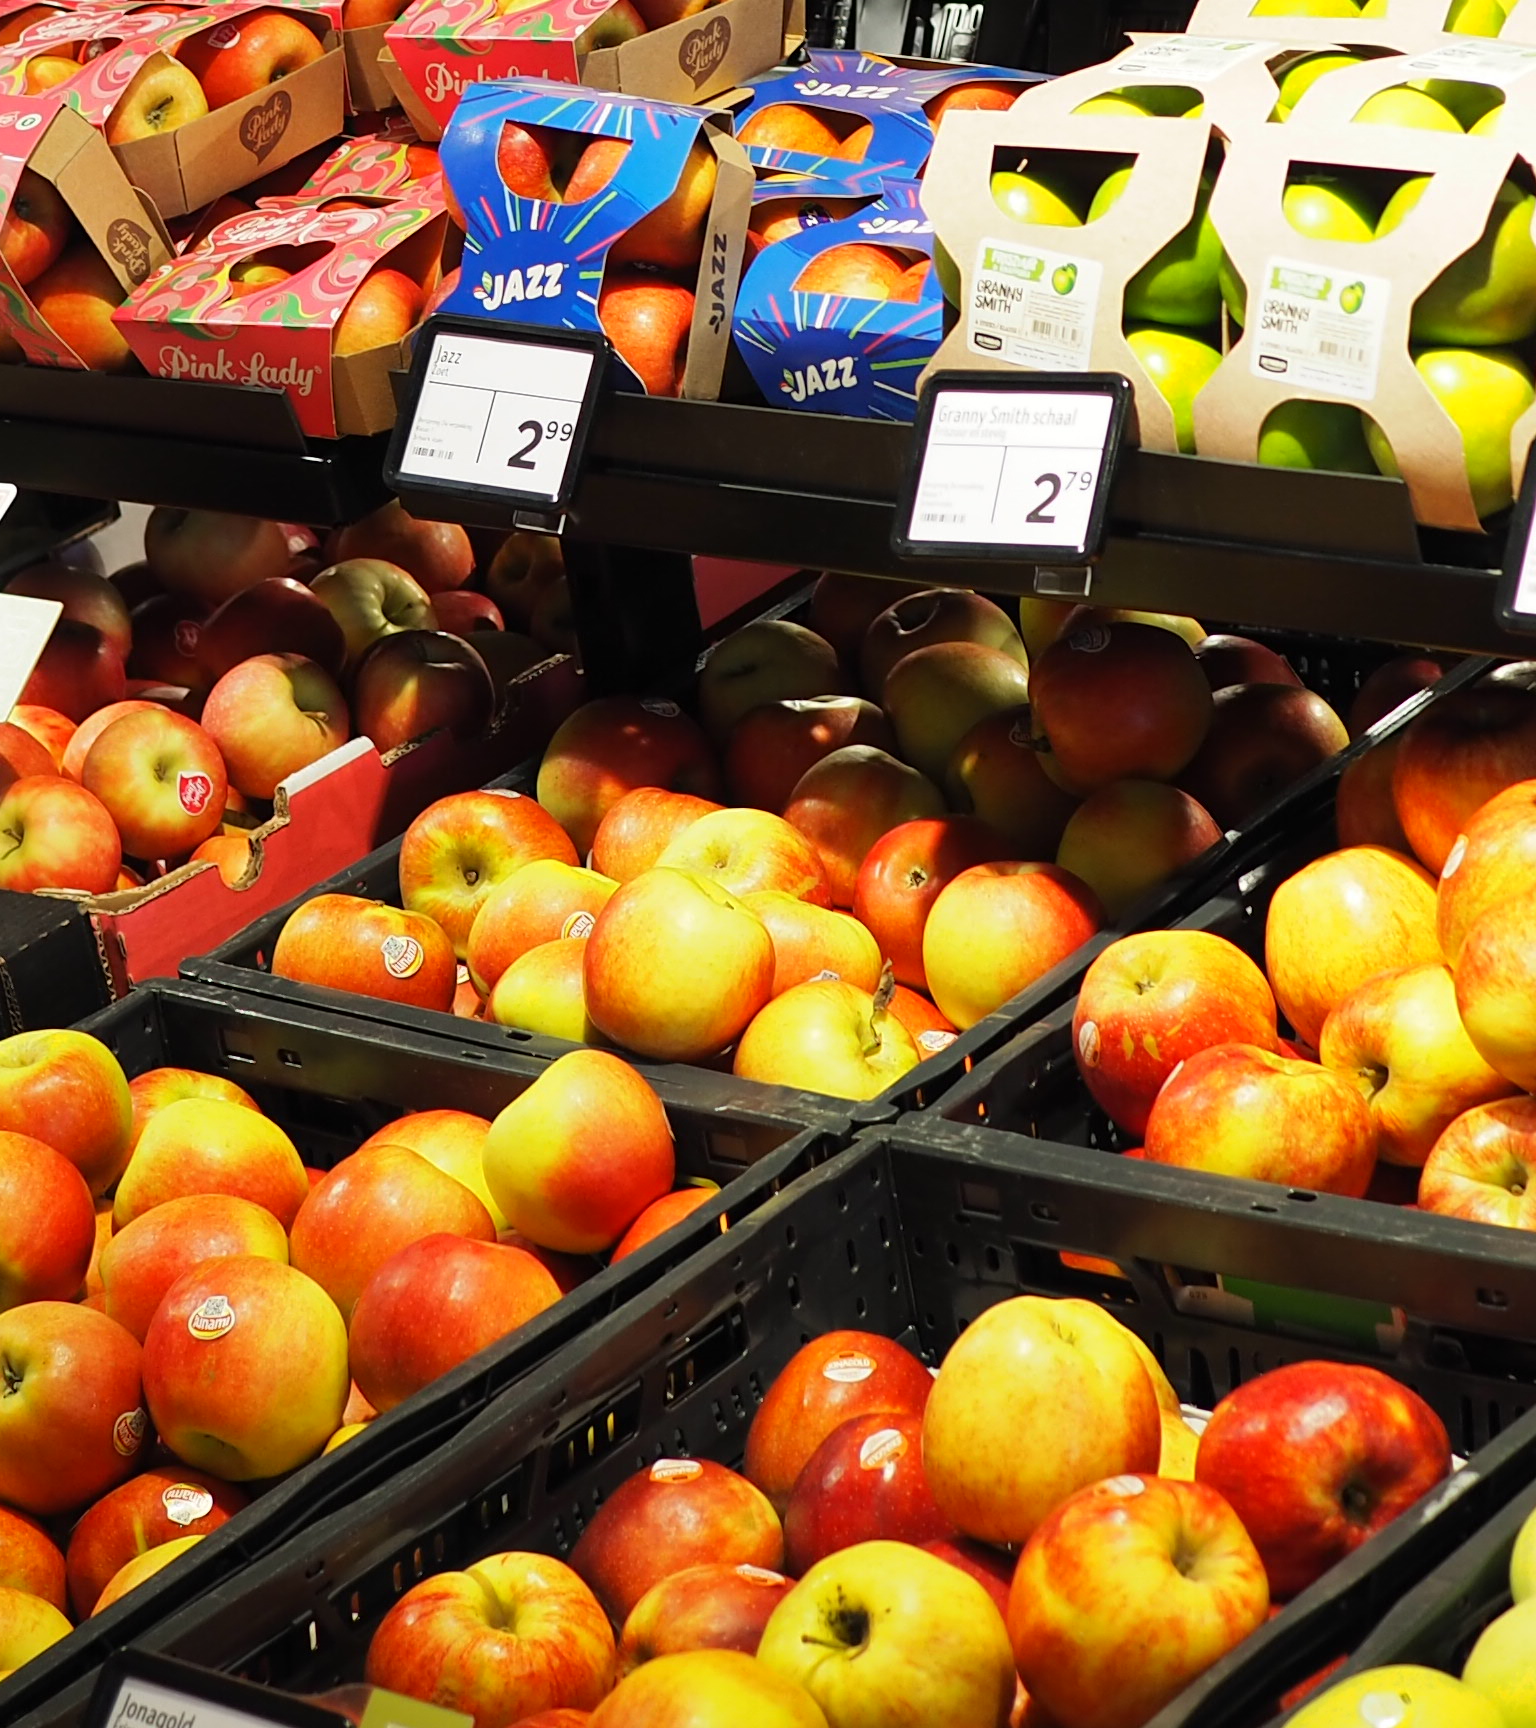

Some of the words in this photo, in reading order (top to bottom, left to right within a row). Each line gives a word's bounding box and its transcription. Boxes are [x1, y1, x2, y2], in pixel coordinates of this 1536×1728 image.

[685, 21, 722, 65] Pink
[691, 42, 724, 77] Lady
[804, 80, 900, 100] JAZZ
[247, 98, 283, 140] Pink
[254, 114, 286, 150] Lady
[868, 218, 935, 234] JAZ
[478, 261, 566, 311] JAZZ
[710, 233, 728, 327] JAZZ
[976, 279, 1024, 302] GRANNY
[974, 294, 1012, 313] SMITH
[159, 344, 237, 382] Pink
[240, 351, 316, 396] Lady
[434, 345, 463, 365] Jazz
[786, 357, 859, 403] JAZZ
[938, 404, 988, 428] Granny
[989, 405, 1030, 425] Smith
[1033, 407, 1079, 426] schaal
[117, 1692, 195, 1728] Jonagold
